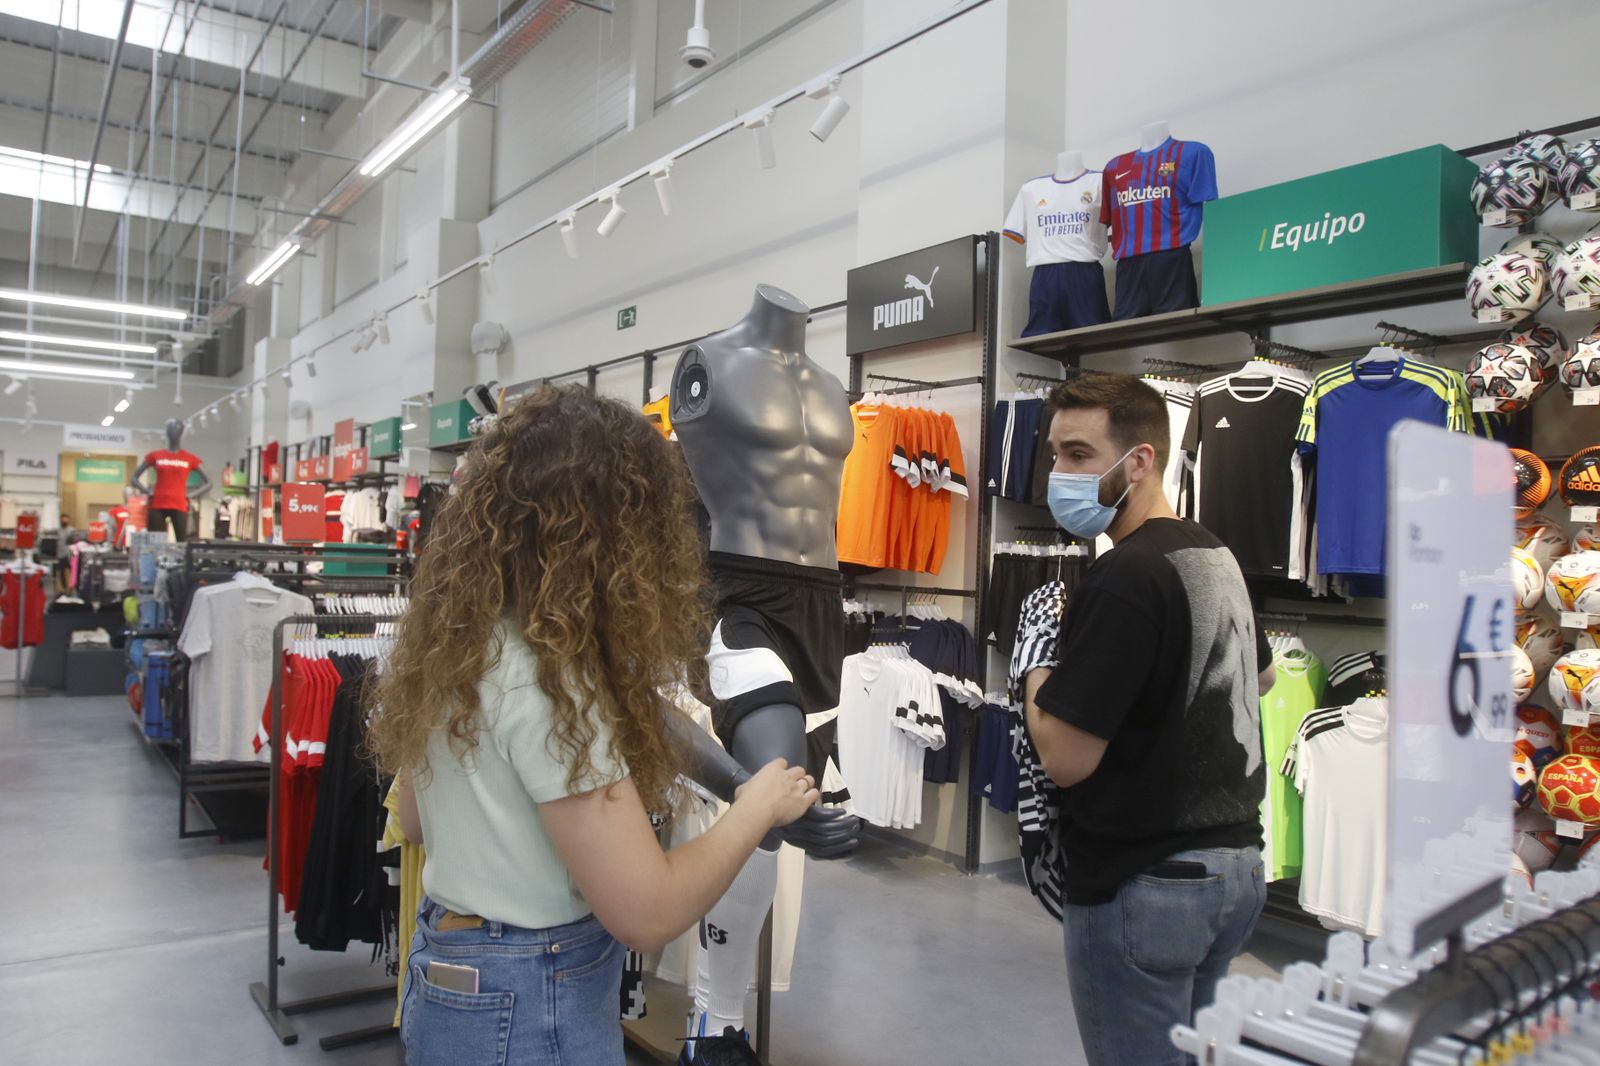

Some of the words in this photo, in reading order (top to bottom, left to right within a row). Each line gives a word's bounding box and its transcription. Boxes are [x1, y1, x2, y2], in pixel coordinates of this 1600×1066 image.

[1037, 211, 1090, 227] Emirates
[1271, 211, 1365, 252] Equipo
[873, 295, 924, 330] PUMA
[17, 458, 47, 468] FILA
[1568, 482, 1600, 492] adida
[1548, 772, 1584, 785] ESPAÑA
